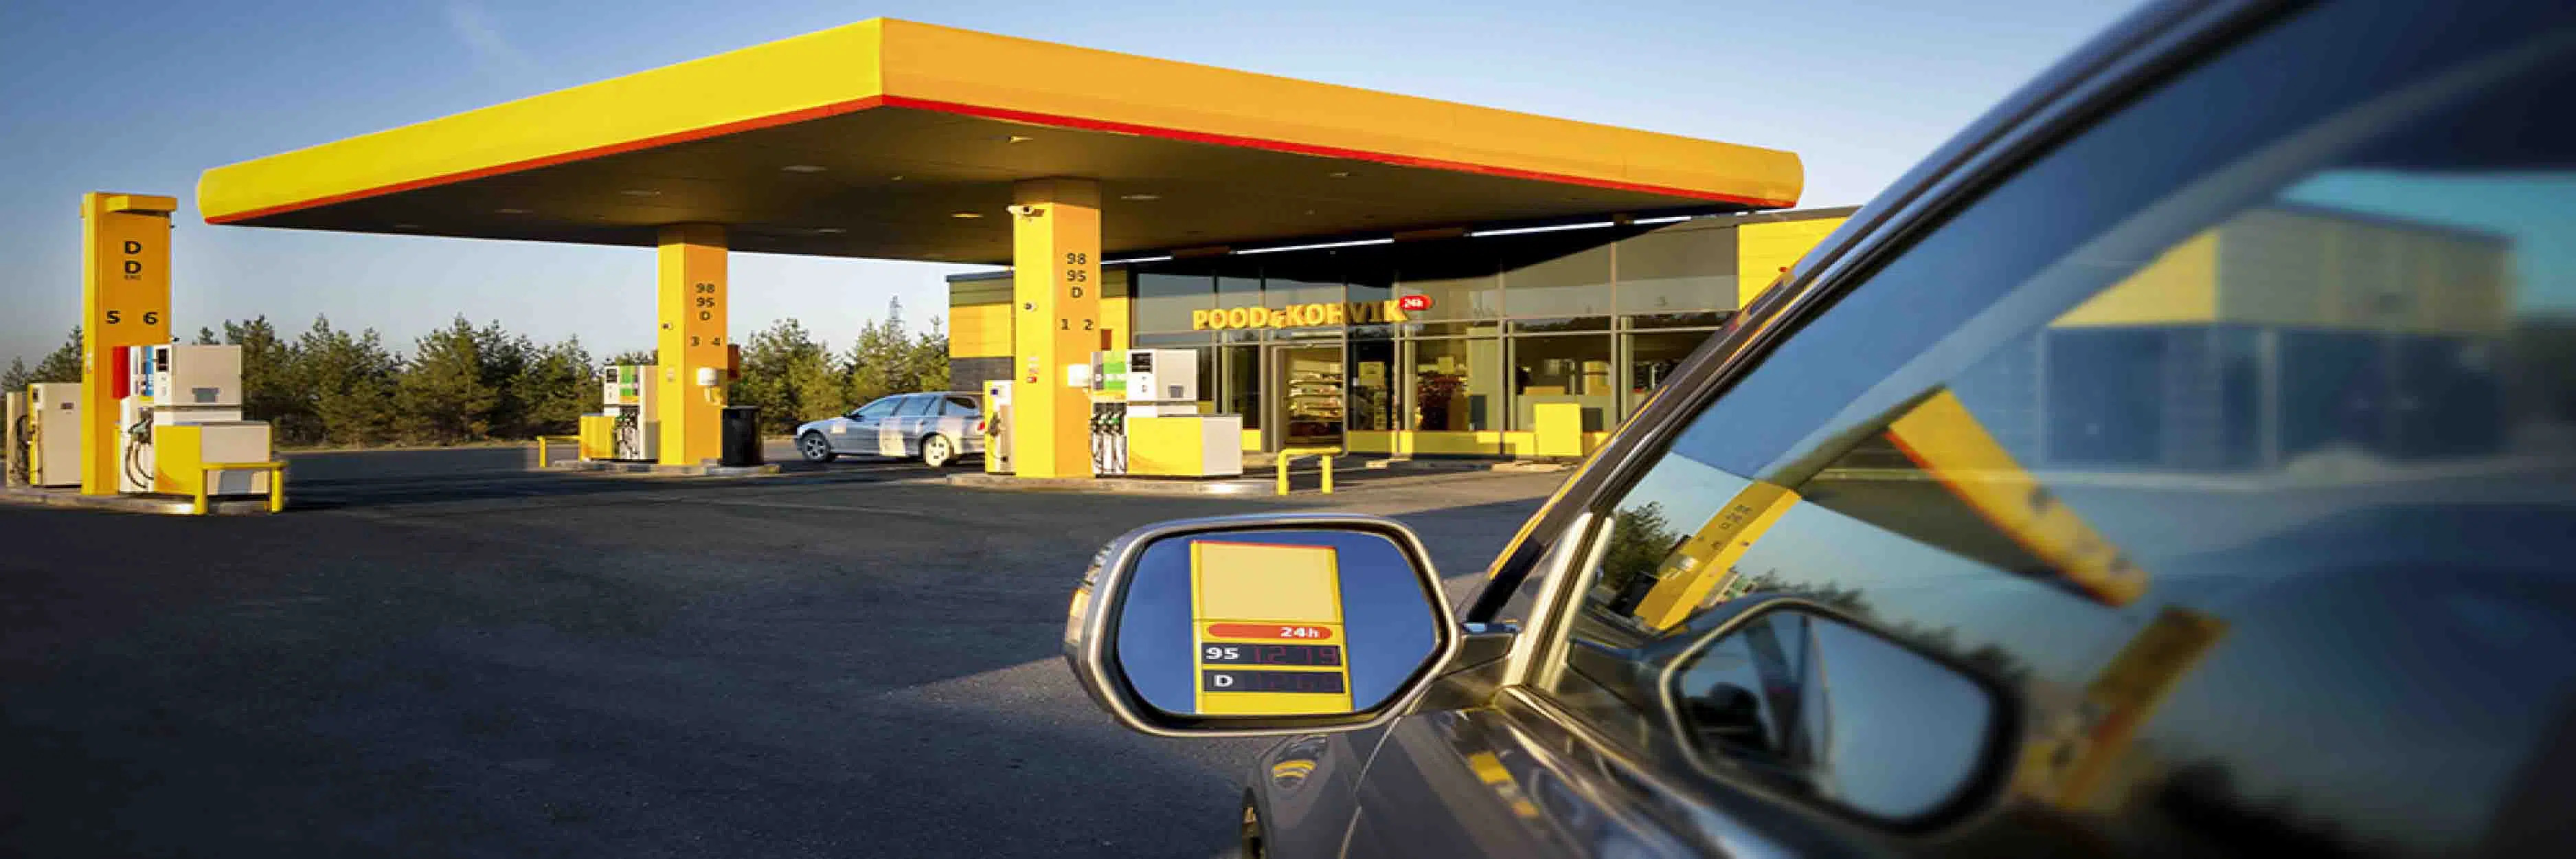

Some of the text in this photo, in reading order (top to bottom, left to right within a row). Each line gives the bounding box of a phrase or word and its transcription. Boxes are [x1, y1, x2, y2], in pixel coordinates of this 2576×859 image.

[124, 241, 142, 254] D
[1065, 252, 1087, 265] 98
[124, 260, 142, 274] D
[1065, 269, 1087, 282] 95
[696, 282, 715, 293] 98
[1071, 286, 1083, 298] D
[696, 297, 715, 308] 95
[106, 310, 159, 324] 5 6
[699, 311, 710, 321] D
[1061, 318, 1094, 331] 1 2
[691, 335, 721, 347] 3 4
[1280, 626, 1319, 638] 24h
[1206, 647, 1239, 660] 95
[1214, 674, 1233, 687] D
